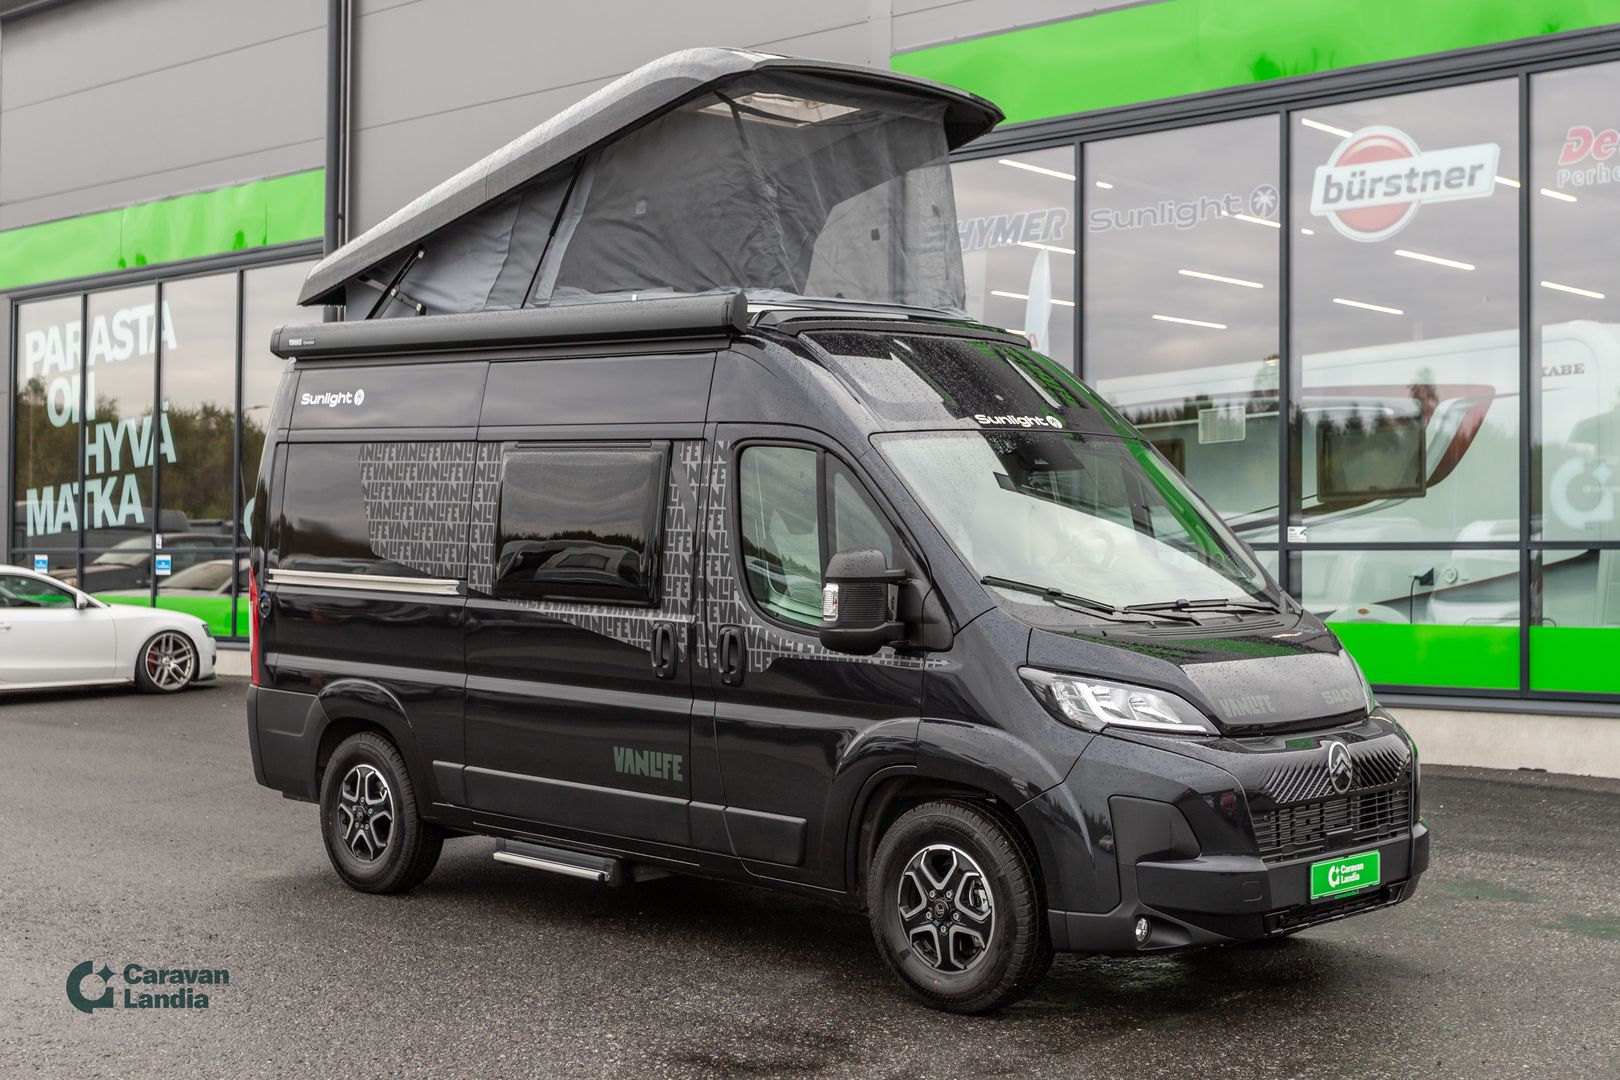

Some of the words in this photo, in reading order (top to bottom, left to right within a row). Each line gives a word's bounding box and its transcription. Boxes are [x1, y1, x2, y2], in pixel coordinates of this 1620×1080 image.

[1322, 164, 1485, 205] bürstner
[1088, 194, 1243, 233] Sunlight
[24, 301, 178, 379] PARASTA
[300, 392, 352, 408] Sunlight
[974, 414, 1050, 428] Sunlight
[26, 473, 145, 538] MATKA
[1219, 694, 1276, 718] VANLIFE
[613, 746, 683, 781] VANLIFE
[1340, 863, 1364, 874] Caravan
[1340, 872, 1360, 884] Landia
